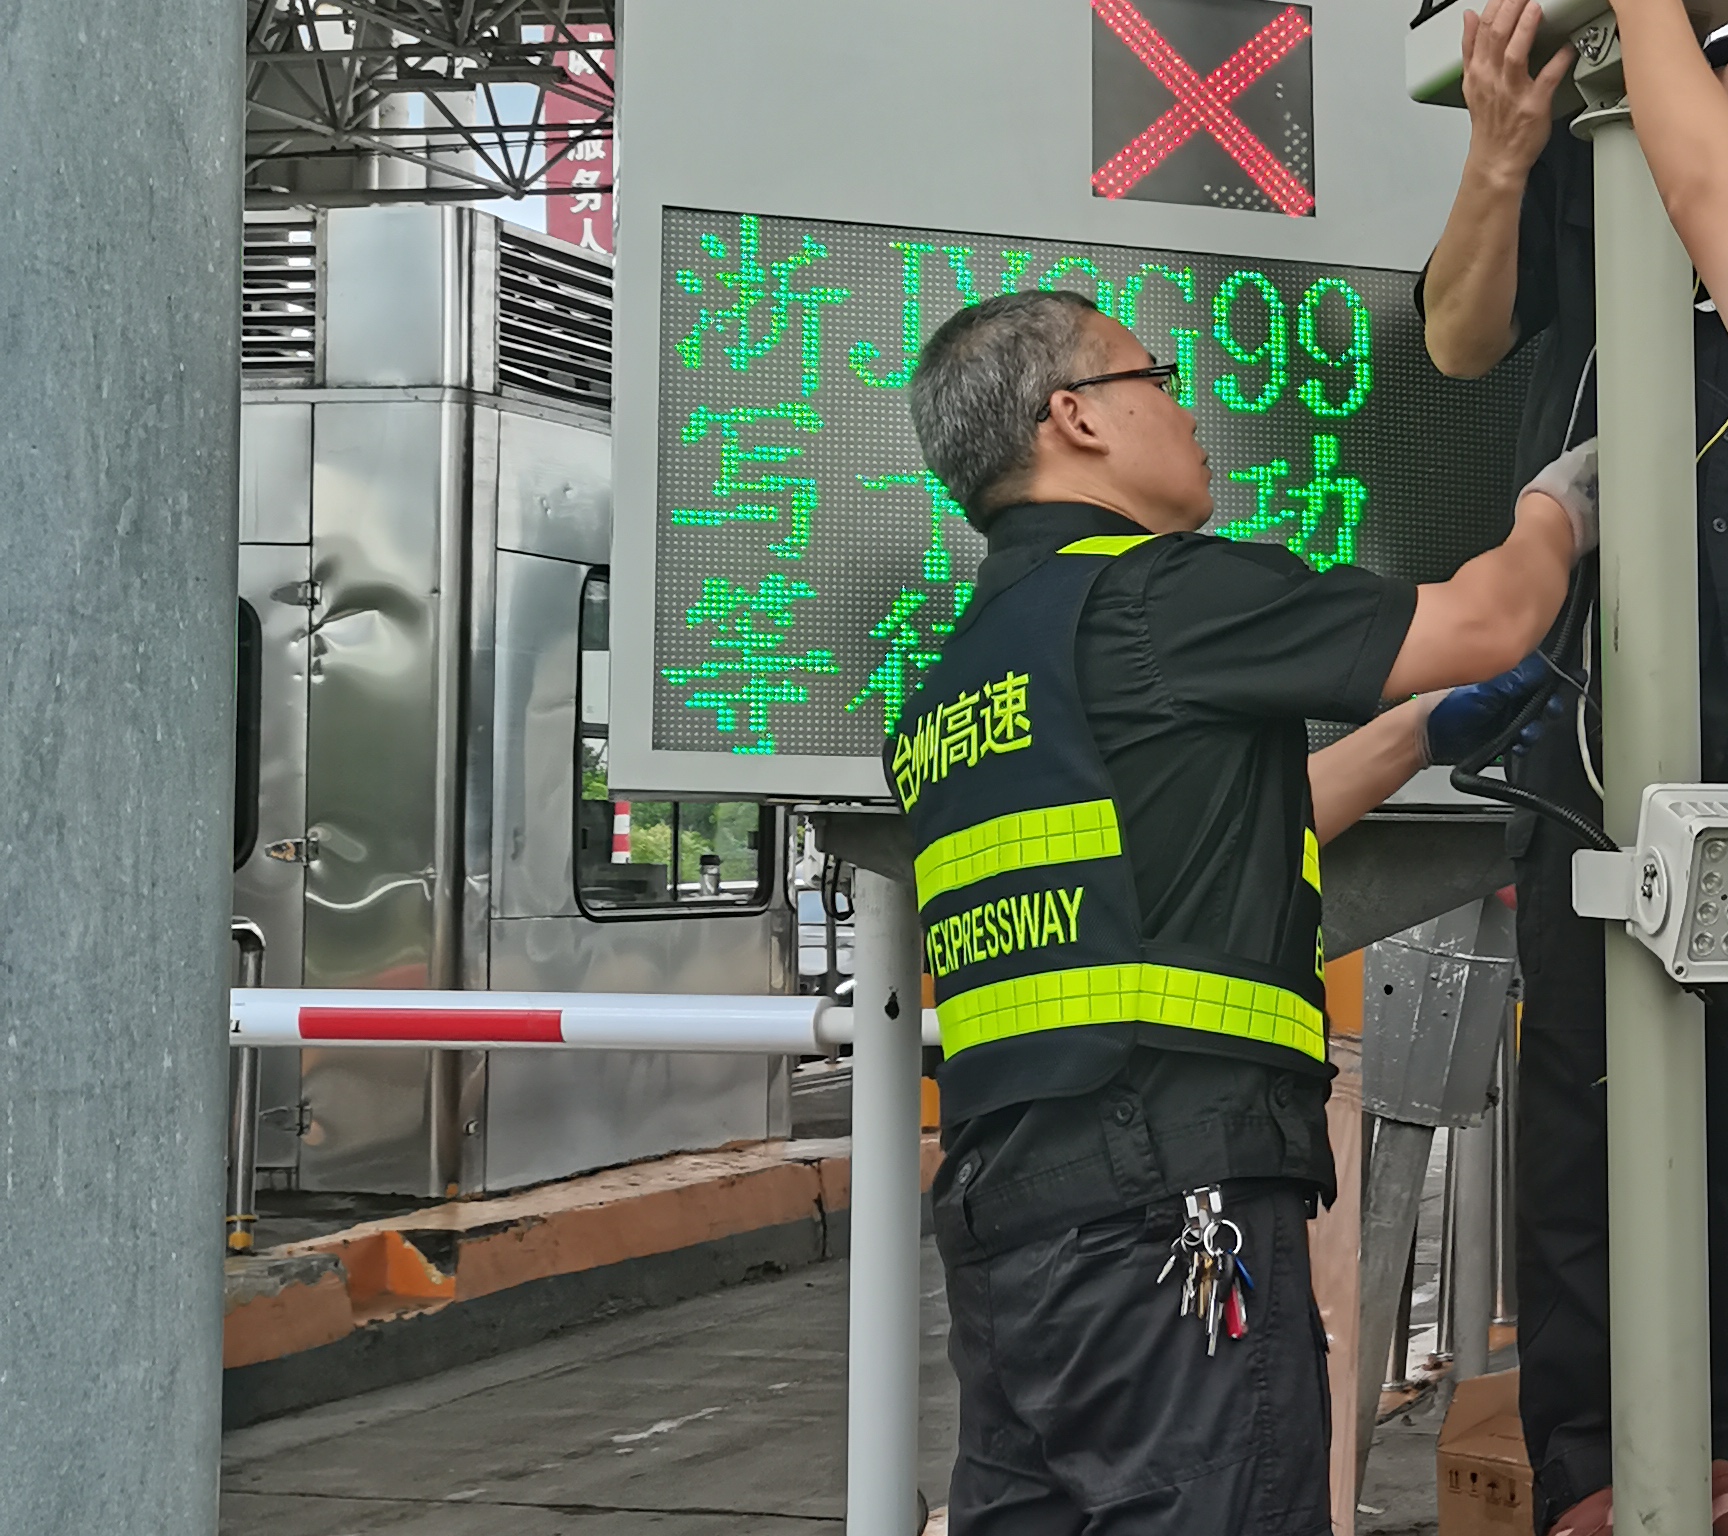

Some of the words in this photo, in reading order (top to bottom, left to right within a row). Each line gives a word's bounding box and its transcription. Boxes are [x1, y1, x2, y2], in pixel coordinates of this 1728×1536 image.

[675, 214, 1373, 419] 浙JG99
[892, 671, 1033, 814] 台州高速
[931, 886, 1085, 978] EXPRESSWAY
